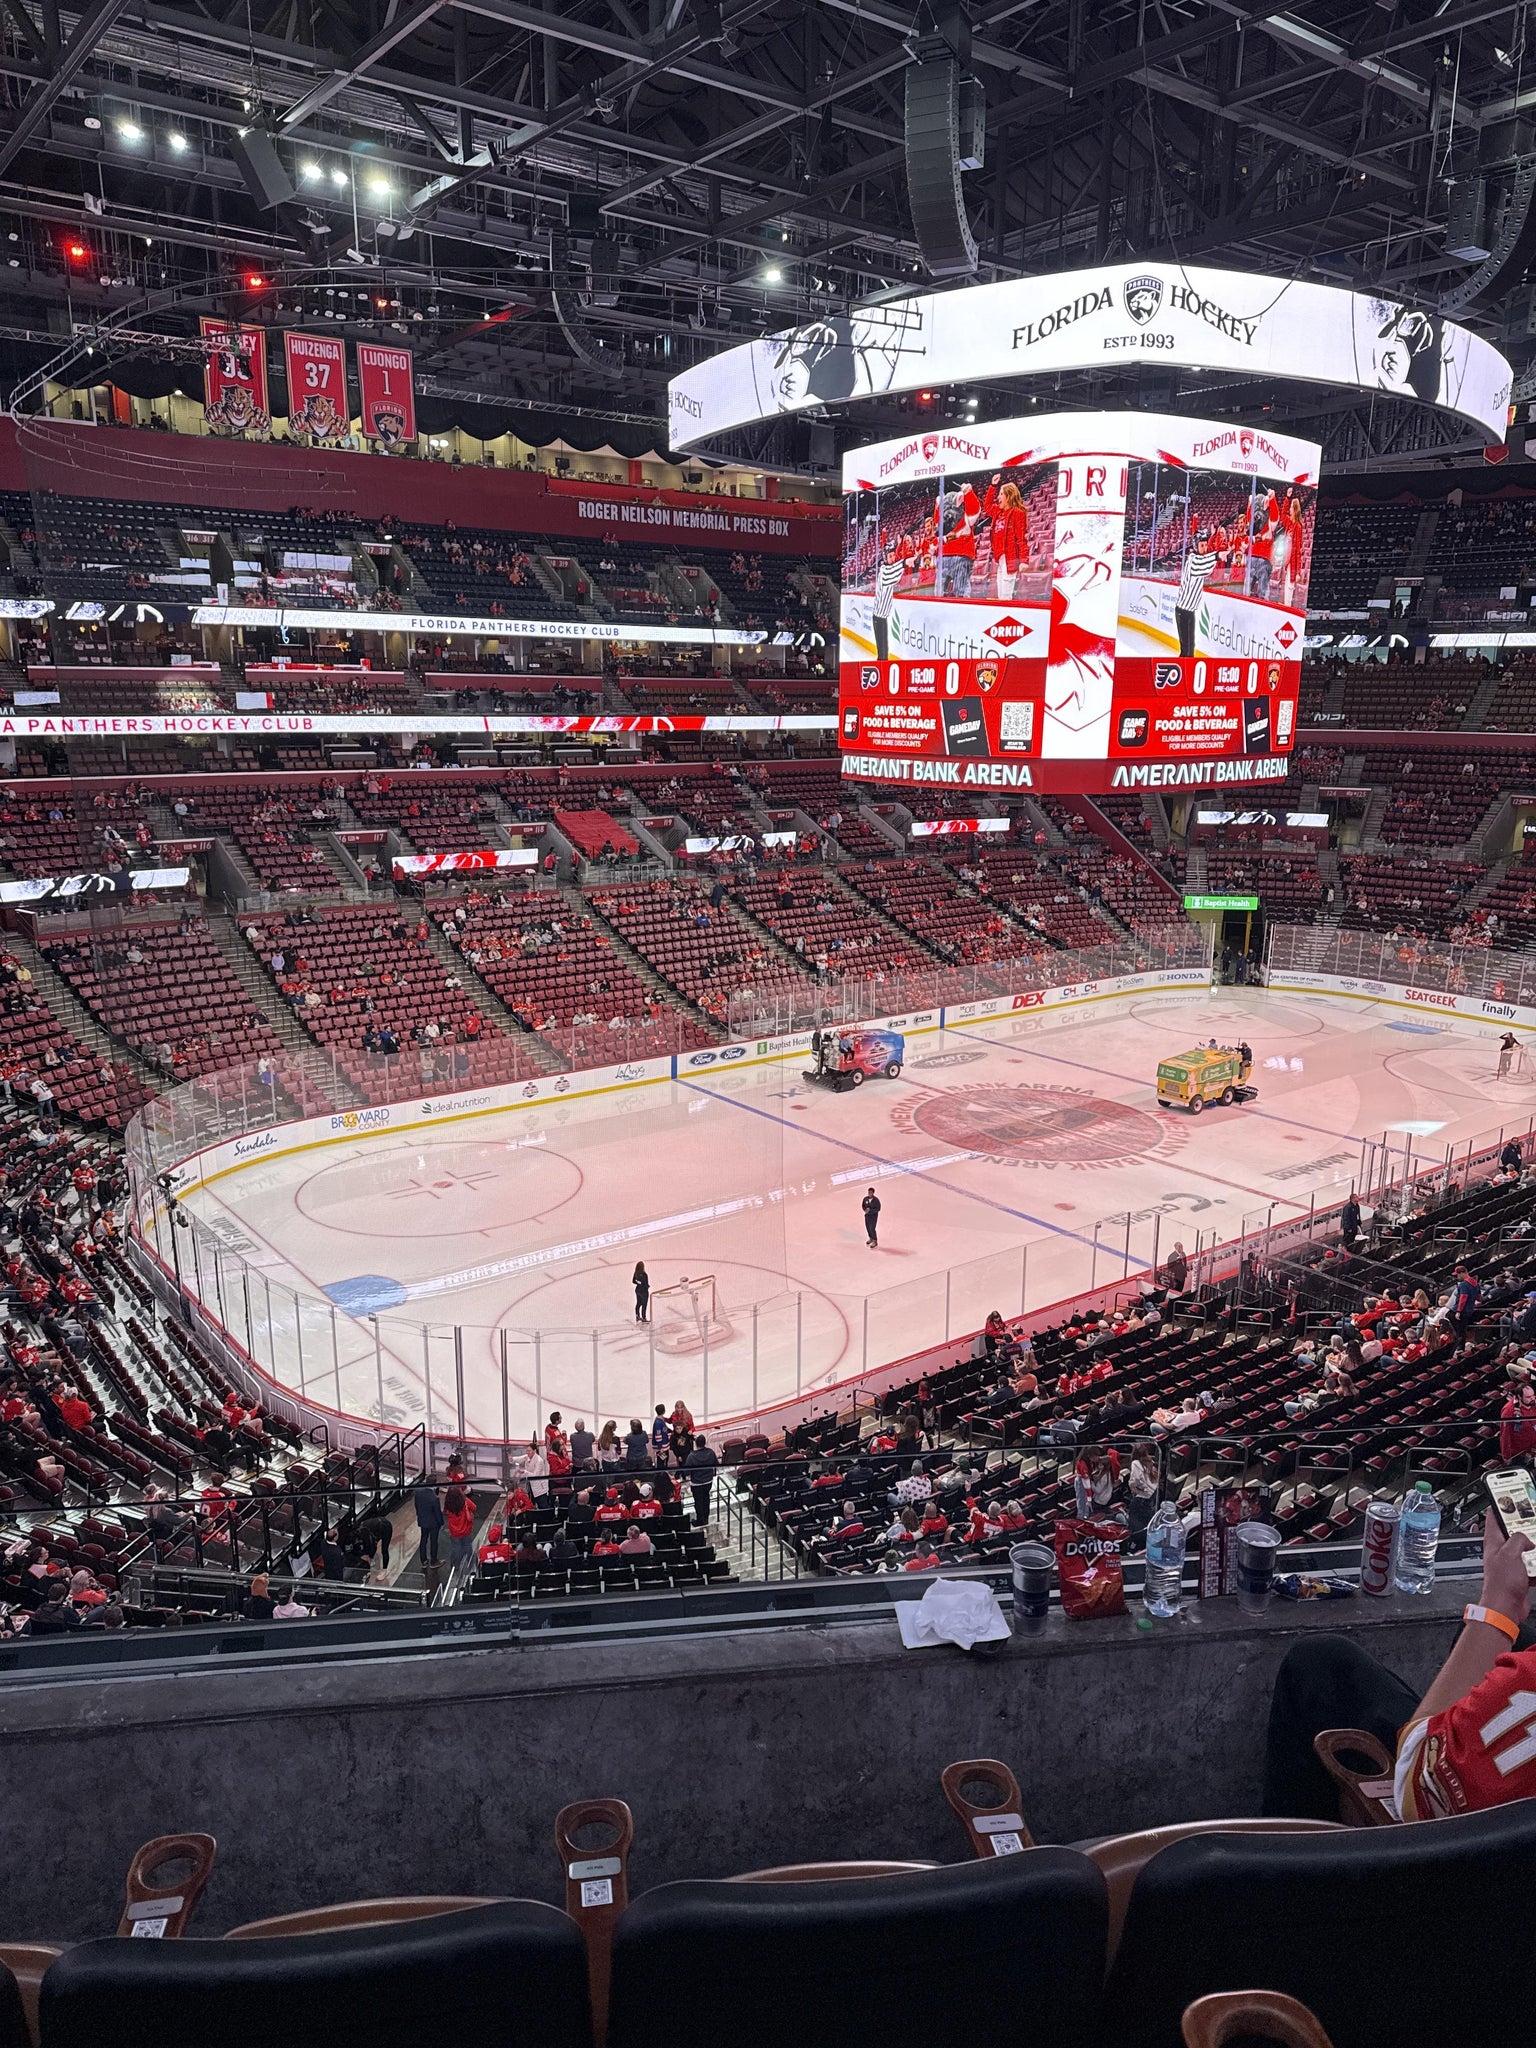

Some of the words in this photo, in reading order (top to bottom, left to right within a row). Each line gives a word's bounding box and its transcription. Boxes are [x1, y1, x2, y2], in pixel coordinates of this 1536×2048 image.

[1126, 277, 1163, 291] PANTHERS
[1011, 286, 1114, 349] FLORIDA
[1170, 285, 1258, 346] HOCKEY
[1140, 332, 1175, 349] 1993
[290, 338, 340, 361] HUIZENGA
[363, 349, 407, 371] LUONGO
[304, 361, 331, 389] 37
[382, 370, 392, 396] 1
[675, 391, 703, 418] HOCKEY
[879, 441, 919, 478] FLORIDA
[942, 435, 992, 461] HOCKEY
[1192, 430, 1237, 457] FLORIDA
[1256, 436, 1289, 472] HOCKEY
[928, 463, 946, 475] 1993
[1244, 461, 1259, 473] 1993
[578, 500, 619, 522] ROGER
[621, 504, 671, 526] NEILSON
[673, 509, 731, 531] MEMORIAL
[733, 515, 767, 535] PRESS
[768, 519, 790, 537] BOX
[411, 618, 466, 630] FLORIDA
[472, 621, 536, 633] PANTHERS
[541, 624, 587, 636] HOCKEY
[591, 626, 620, 637] CLUB
[990, 625, 1025, 638] ORKIN
[1278, 628, 1295, 642] ORKIN
[901, 620, 1018, 659] idealnutriti
[888, 663, 900, 695] 0
[910, 668, 935, 684] 15:00
[945, 662, 960, 695] 0
[1192, 660, 1207, 694] 0
[1217, 667, 1240, 683] 15:00
[1246, 661, 1259, 694] 0
[1214, 685, 1240, 693] PRE-GAME
[874, 706, 895, 717] SAVE
[896, 705, 907, 717] 5%
[908, 705, 921, 716] ON
[1173, 706, 1198, 718] SAVE
[1199, 706, 1212, 717] 5%
[1212, 705, 1226, 716] ON
[3, 719, 15, 733] A
[28, 718, 153, 733] PANTHERS
[164, 717, 251, 731] HOCKEY
[261, 717, 313, 730] CLUB
[862, 718, 883, 728] FOOD
[883, 718, 889, 728] &
[889, 718, 937, 730] BEVERAGE
[949, 720, 981, 736] GAMEDAY
[1123, 717, 1146, 728] GAME
[1155, 720, 1184, 731] FOOD
[1184, 719, 1192, 730] &
[1193, 718, 1239, 730] BEVERAGE
[867, 731, 885, 739] ELIGIBLE
[885, 732, 907, 740] MEMBERS
[906, 733, 929, 741] QUALIFY
[872, 738, 881, 746] FOR
[894, 739, 921, 748] DISCOUNTS
[1161, 734, 1185, 742] ELIGIBLE
[1185, 734, 1210, 742] MEMBERS
[1211, 733, 1232, 742] QUALIFY
[1168, 742, 1178, 750] FOR
[1178, 742, 1194, 750] MORE
[1194, 741, 1225, 750] DISCOUNTS
[841, 755, 912, 779] AMERANT
[913, 760, 962, 782] BANK
[963, 763, 1033, 787] ARENA
[1111, 762, 1215, 788] AMERANT
[1215, 759, 1255, 782] BANK
[1255, 757, 1288, 779] ARENA
[1204, 899, 1228, 908] Baptist
[1228, 899, 1251, 907] Health
[1166, 972, 1205, 980] HONDA
[1063, 986, 1077, 997] CH
[1084, 983, 1098, 993] CH
[1012, 991, 1047, 1010] DEX
[1404, 989, 1457, 1008] SEATGEEK
[1482, 1001, 1517, 1019] finally
[769, 1039, 791, 1051] Baptist
[792, 1036, 812, 1047] Health
[694, 1053, 713, 1065] Ford
[724, 1048, 743, 1060] Ford
[433, 1095, 491, 1113] idealnutrition
[890, 1091, 936, 1135] AMERANT
[946, 1082, 1011, 1093] BANK
[1016, 1082, 1096, 1096] ARENA
[358, 1119, 391, 1131] COUNTY
[234, 1133, 278, 1157] Sandals
[1067, 1153, 1145, 1171] BANK
[1270, 1151, 1360, 1182] AutoNation
[1109, 1203, 1181, 1227] CELSIUS
[1066, 1537, 1121, 1557] Doritos
[1361, 1520, 1394, 1593] Coke
